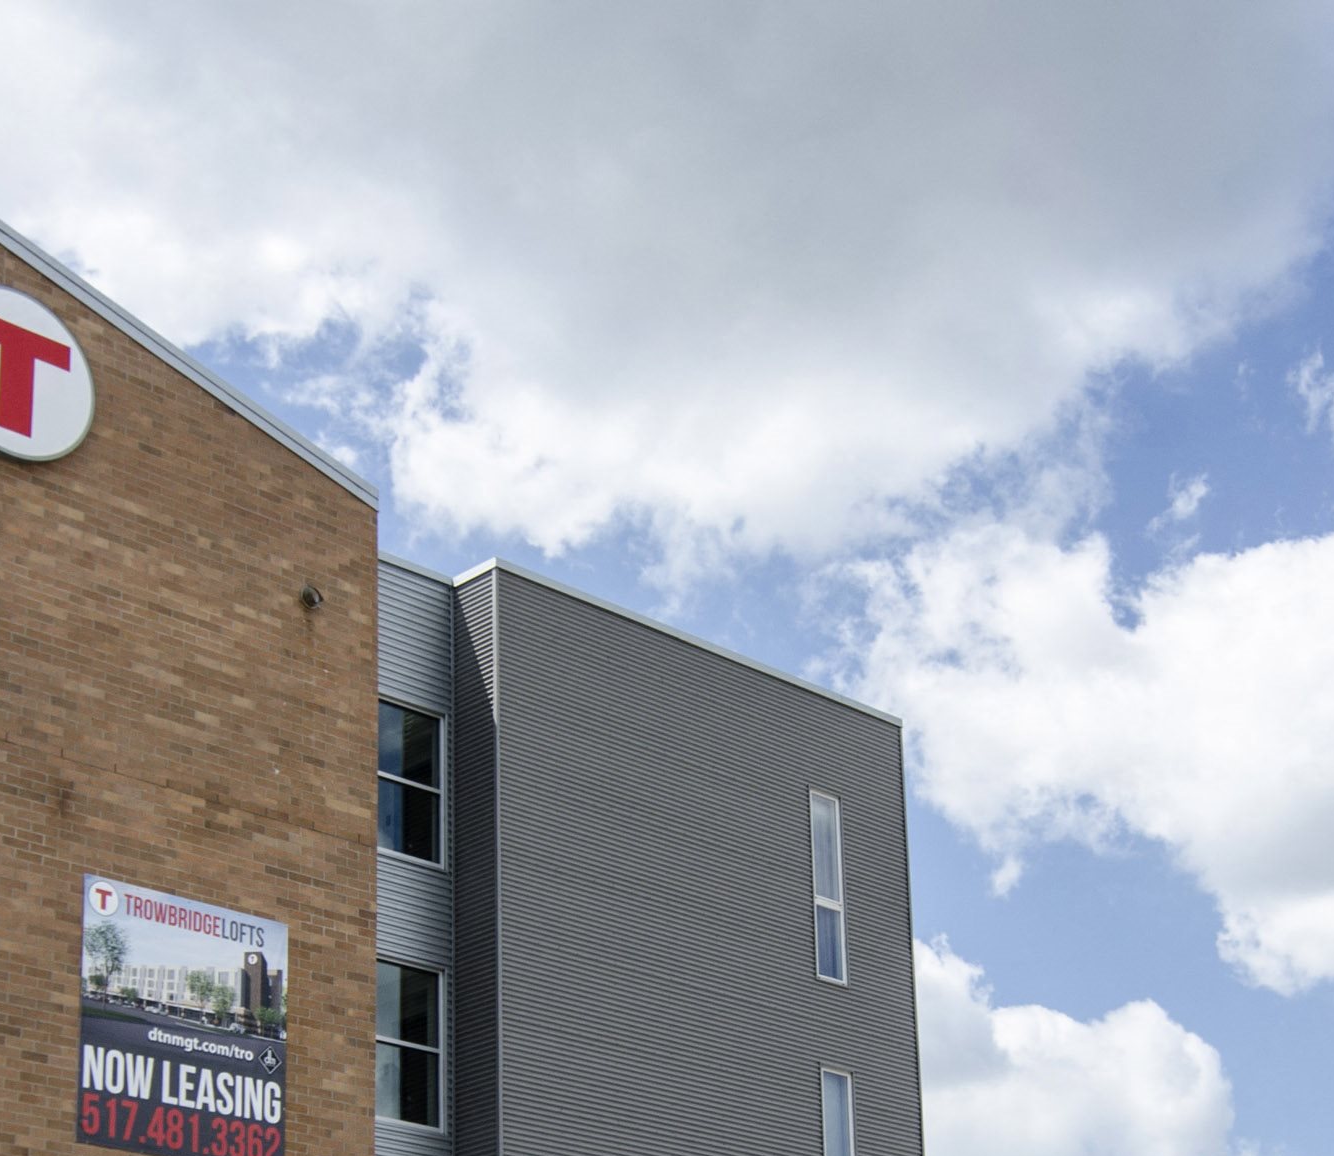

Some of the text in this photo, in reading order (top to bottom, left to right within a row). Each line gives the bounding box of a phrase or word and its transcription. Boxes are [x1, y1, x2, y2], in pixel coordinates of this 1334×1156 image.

[148, 1027, 254, 1062] dtnmgt.com/tro
[82, 1044, 282, 1124] NOW LEASING
